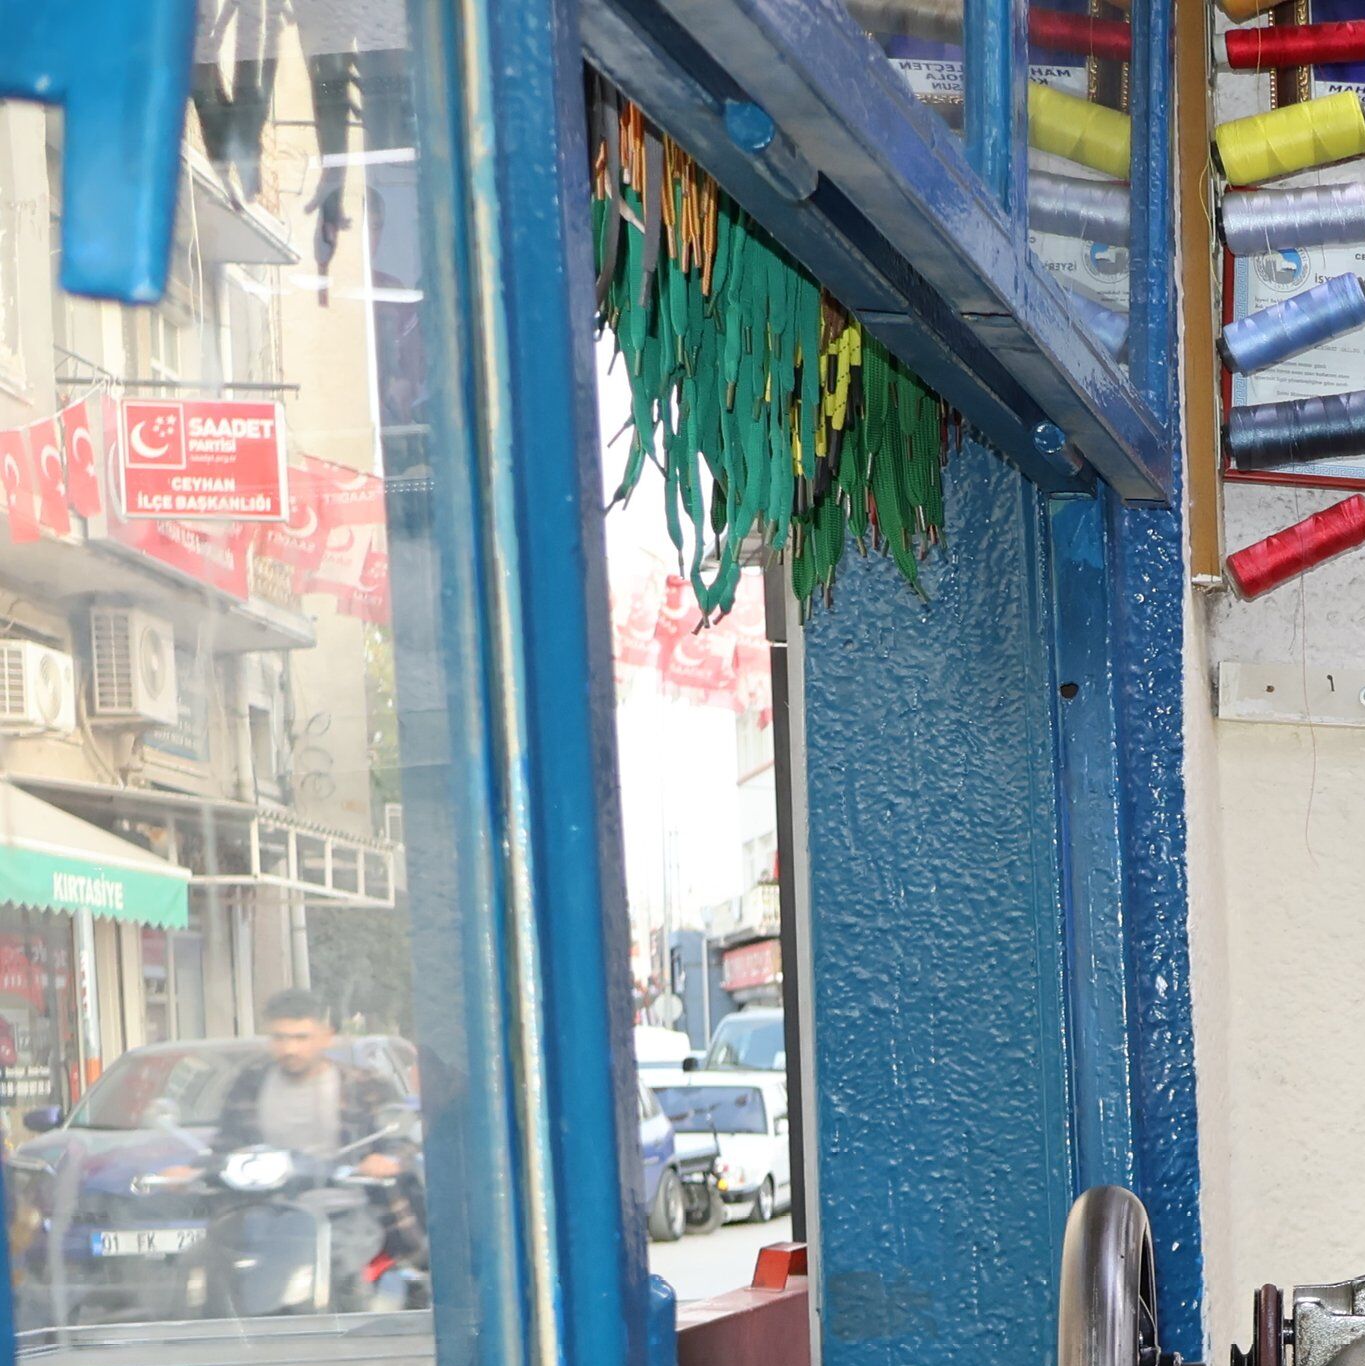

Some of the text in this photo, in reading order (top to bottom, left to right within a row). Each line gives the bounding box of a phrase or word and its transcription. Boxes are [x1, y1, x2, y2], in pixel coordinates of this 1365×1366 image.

[189, 416, 274, 439] SAADET
[189, 437, 237, 453] PARTİSİ
[171, 476, 236, 492] CEYHAN
[137, 492, 272, 512] İLÇE BAŞKANLIĞI
[53, 871, 124, 910] KIRTASİYE
